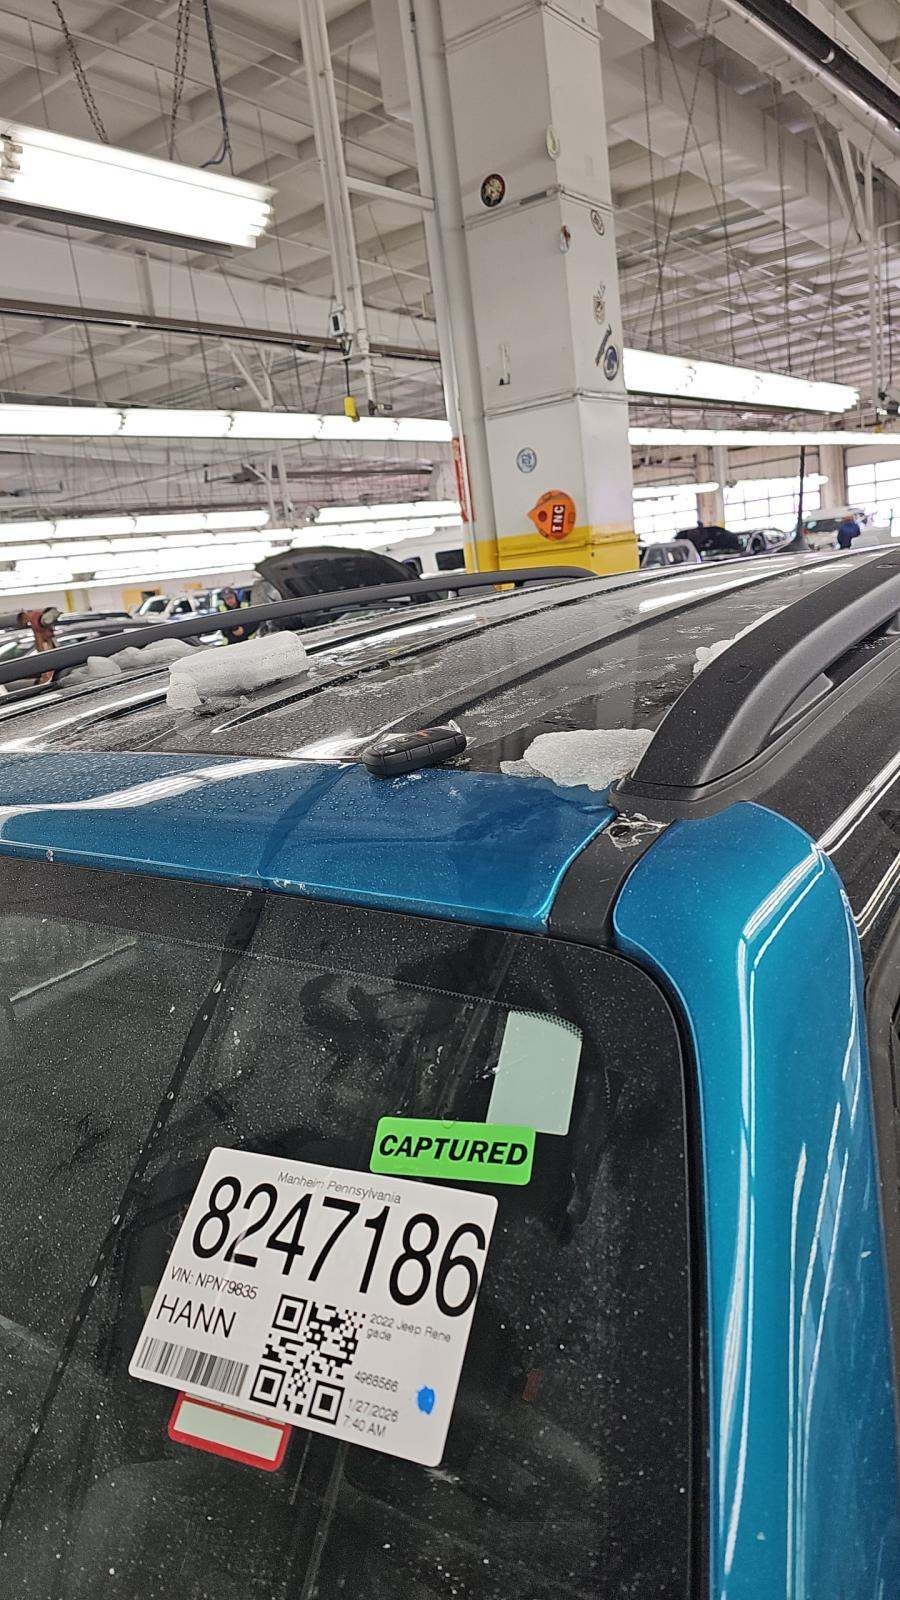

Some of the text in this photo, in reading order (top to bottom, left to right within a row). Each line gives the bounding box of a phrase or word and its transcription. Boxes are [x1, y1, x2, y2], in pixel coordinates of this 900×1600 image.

[551, 506, 565, 532] TNC
[379, 1134, 528, 1166] CAPTURED
[277, 1172, 401, 1203] Manheim Pennsylvania
[192, 1175, 486, 1317] 8247186
[171, 1266, 259, 1300] VIN: NPN79835
[156, 1294, 237, 1338] HANN
[370, 1313, 451, 1343] 2022 Jeep Rene
[366, 1328, 392, 1341] gade
[366, 1422, 387, 1438] AM
